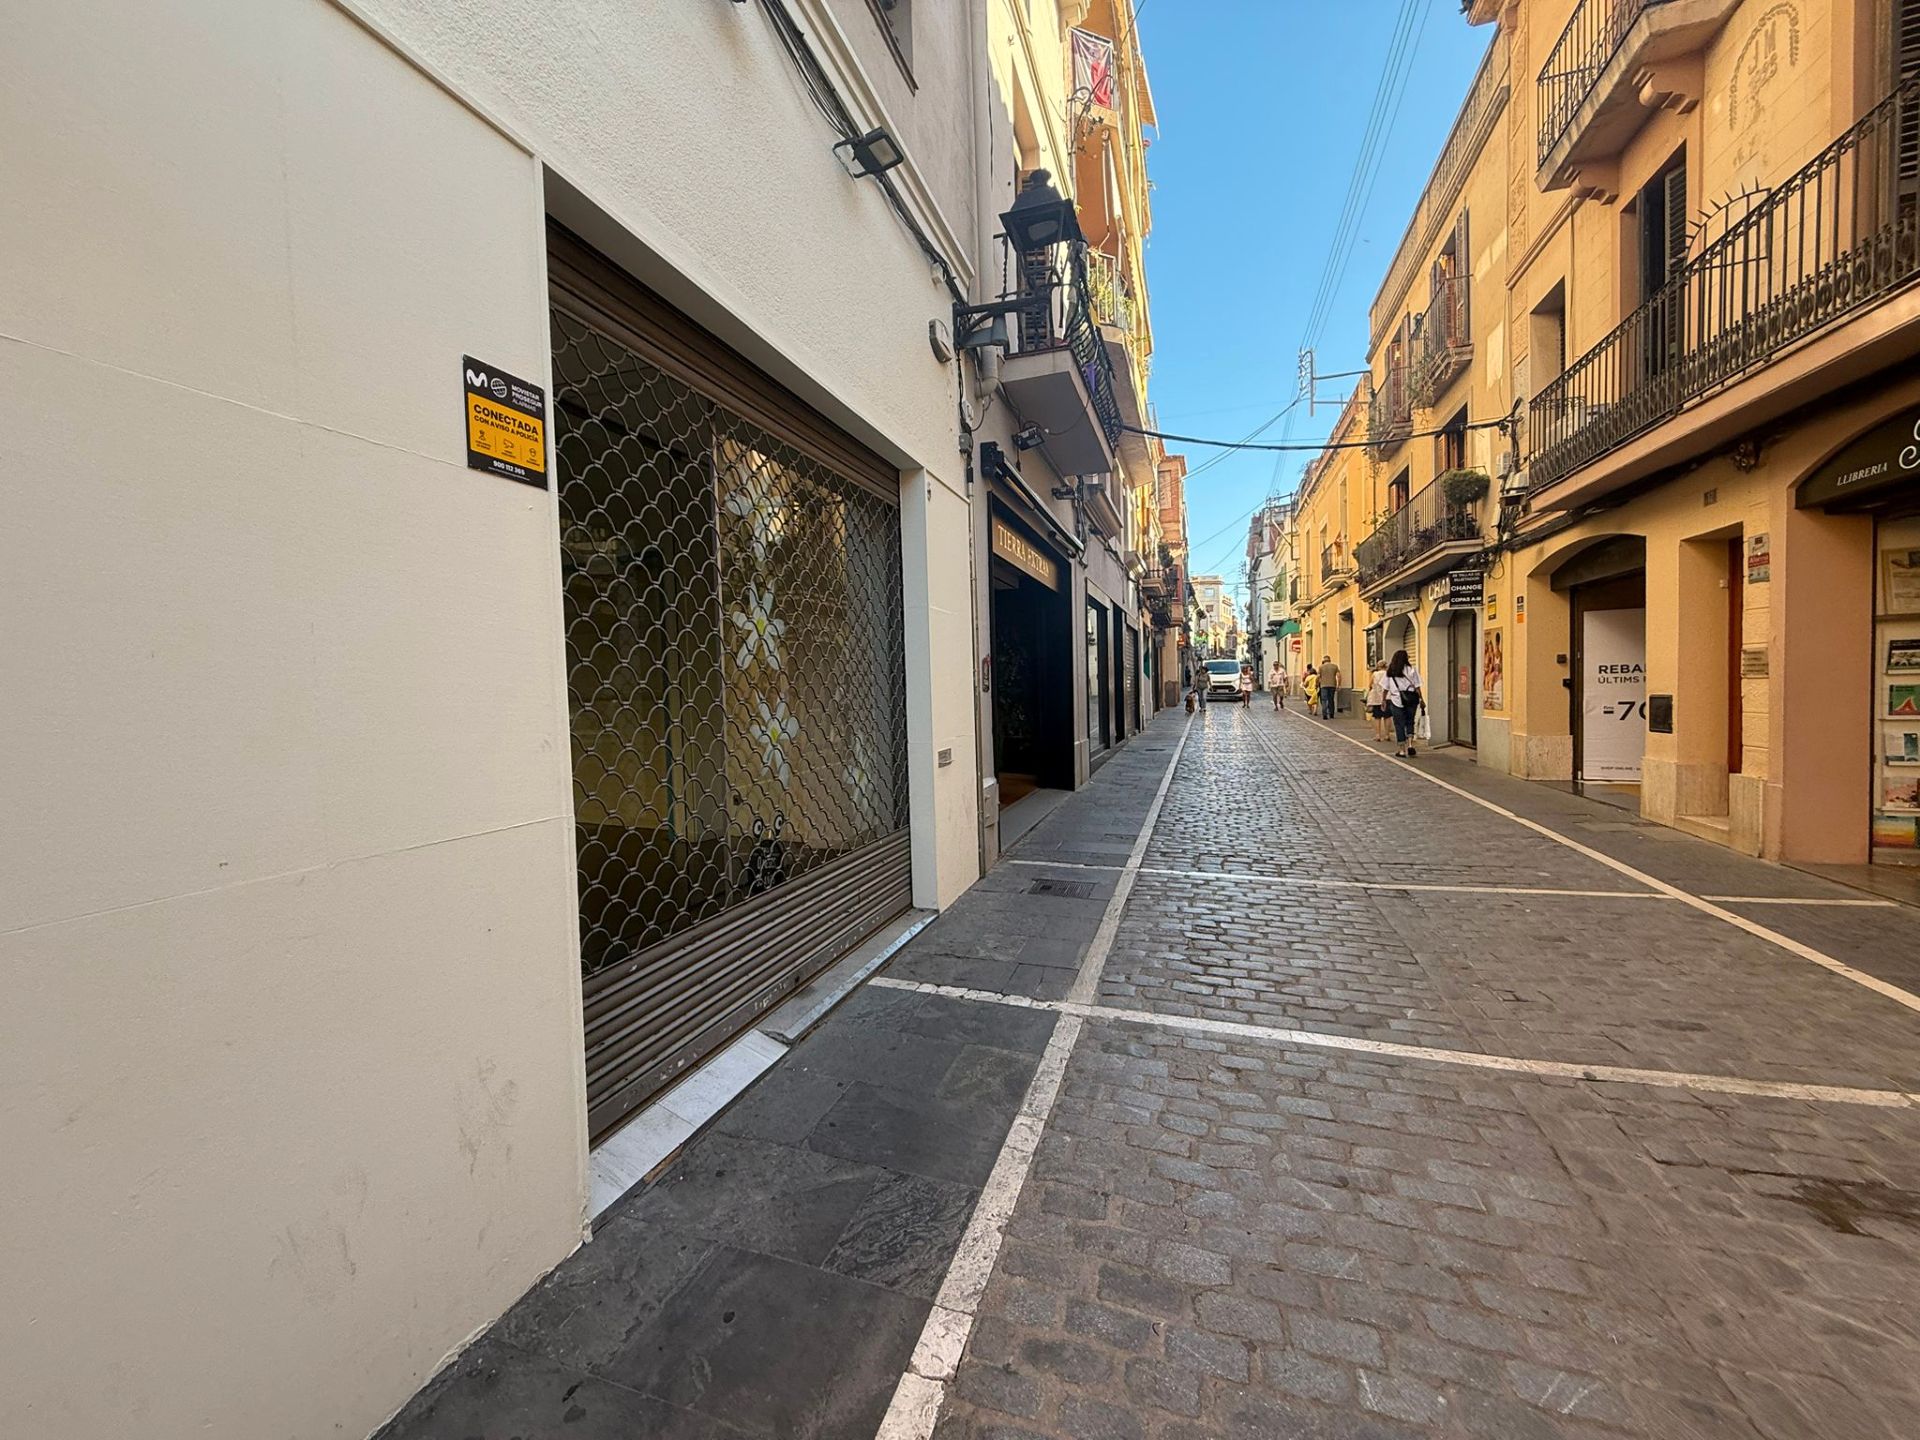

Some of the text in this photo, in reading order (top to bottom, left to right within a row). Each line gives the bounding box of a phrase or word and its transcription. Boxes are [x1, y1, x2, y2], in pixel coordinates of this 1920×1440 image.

[511, 385, 540, 400] MOVISTAR
[511, 391, 543, 408] PROSEGUR
[474, 404, 539, 435] CONECTADA
[474, 415, 490, 425] CON
[490, 421, 510, 432] AVISO
[516, 430, 539, 443] POLICÍA
[493, 460, 505, 469] 900
[505, 464, 514, 472] 112
[1837, 462, 1888, 486] LLIBRERIA
[998, 524, 1026, 562] TIERRA
[1598, 664, 1646, 674] REBA
[1598, 675, 1640, 684] ÚLTIMS
